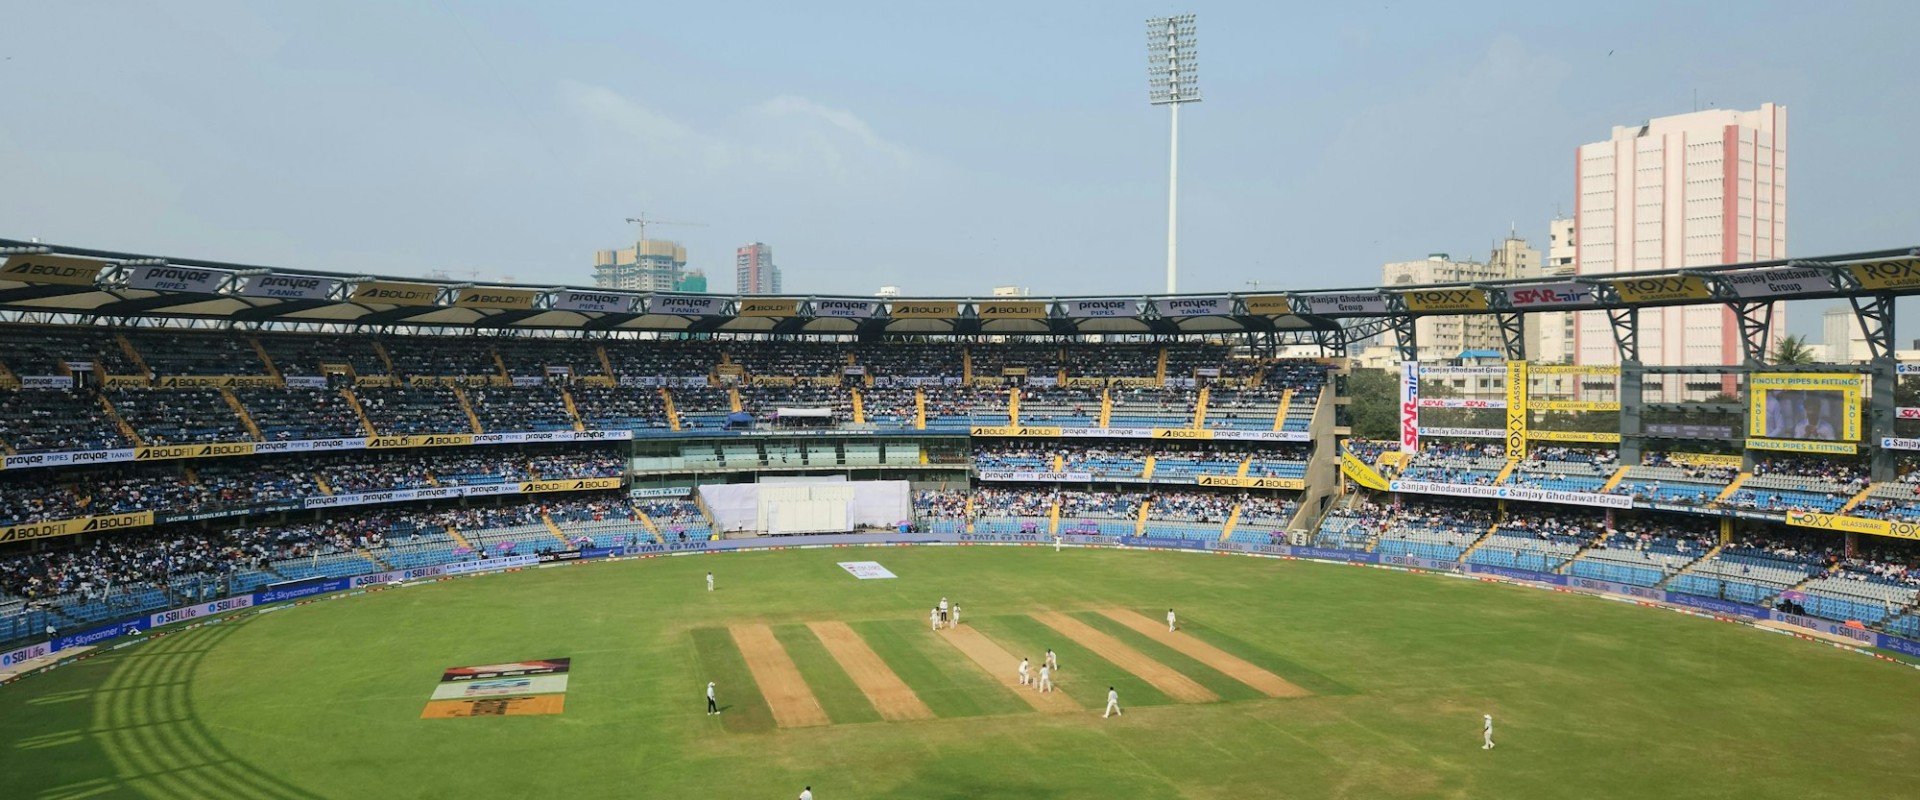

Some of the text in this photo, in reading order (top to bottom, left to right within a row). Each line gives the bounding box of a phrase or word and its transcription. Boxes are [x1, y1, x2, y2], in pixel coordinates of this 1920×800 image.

[33, 265, 98, 280] BOLDFIT
[1730, 269, 1820, 286] Sanjay Ghodawat
[155, 281, 188, 290] PIPES
[1624, 278, 1694, 294] ROXX
[1769, 283, 1802, 293] Group
[267, 289, 303, 297] TANKS
[379, 290, 433, 300] BOLDFIT
[480, 295, 531, 304] BOLDFIT
[1414, 290, 1475, 304] ROXX
[1512, 289, 1557, 303] STAR
[1310, 294, 1382, 306] Sanjay Ghodawat
[1338, 304, 1363, 312] Group
[1402, 397, 1417, 451] STAR
[1427, 428, 1449, 436] Sanjay
[1511, 414, 1523, 458] ROXX
[382, 436, 473, 447] BOLDFIT BOLDFIT
[1783, 442, 1806, 450] PIPES
[1816, 444, 1854, 452] FITTINGS
[152, 444, 253, 458] BOLDFIT BOLDFIT
[534, 480, 618, 492] BOLDFIT BOLDFIT
[1214, 478, 1302, 488] BOLDFIT BOLDFIT
[1401, 482, 1429, 492] Sanjay
[1430, 483, 1470, 494] Ghodawat
[1472, 486, 1497, 497] Group
[1509, 489, 1543, 501] Sanjay
[1546, 490, 1597, 504] Ghodawat
[1599, 494, 1630, 507] Group
[17, 515, 147, 539] BOLDFIT BOLDFIT
[1841, 520, 1920, 537] GLASSWARE ROX
[1230, 543, 1243, 551] Life
[1392, 556, 1419, 566] SBI Life
[1438, 561, 1450, 570] SBI
[412, 566, 441, 577] SBI Life
[364, 574, 393, 585] SBI Life
[1581, 580, 1610, 591] SBI Life
[276, 585, 320, 601] Skyscanner
[1630, 586, 1660, 599] SBI Life
[217, 596, 247, 612] SBI Life
[1690, 599, 1735, 613] Skyscanner
[166, 608, 196, 623] SBI Life
[1785, 614, 1817, 630] SBI Life
[75, 627, 118, 646] Skyscanner
[1839, 626, 1870, 641] SBI Life
[12, 647, 45, 664] SBI Life
